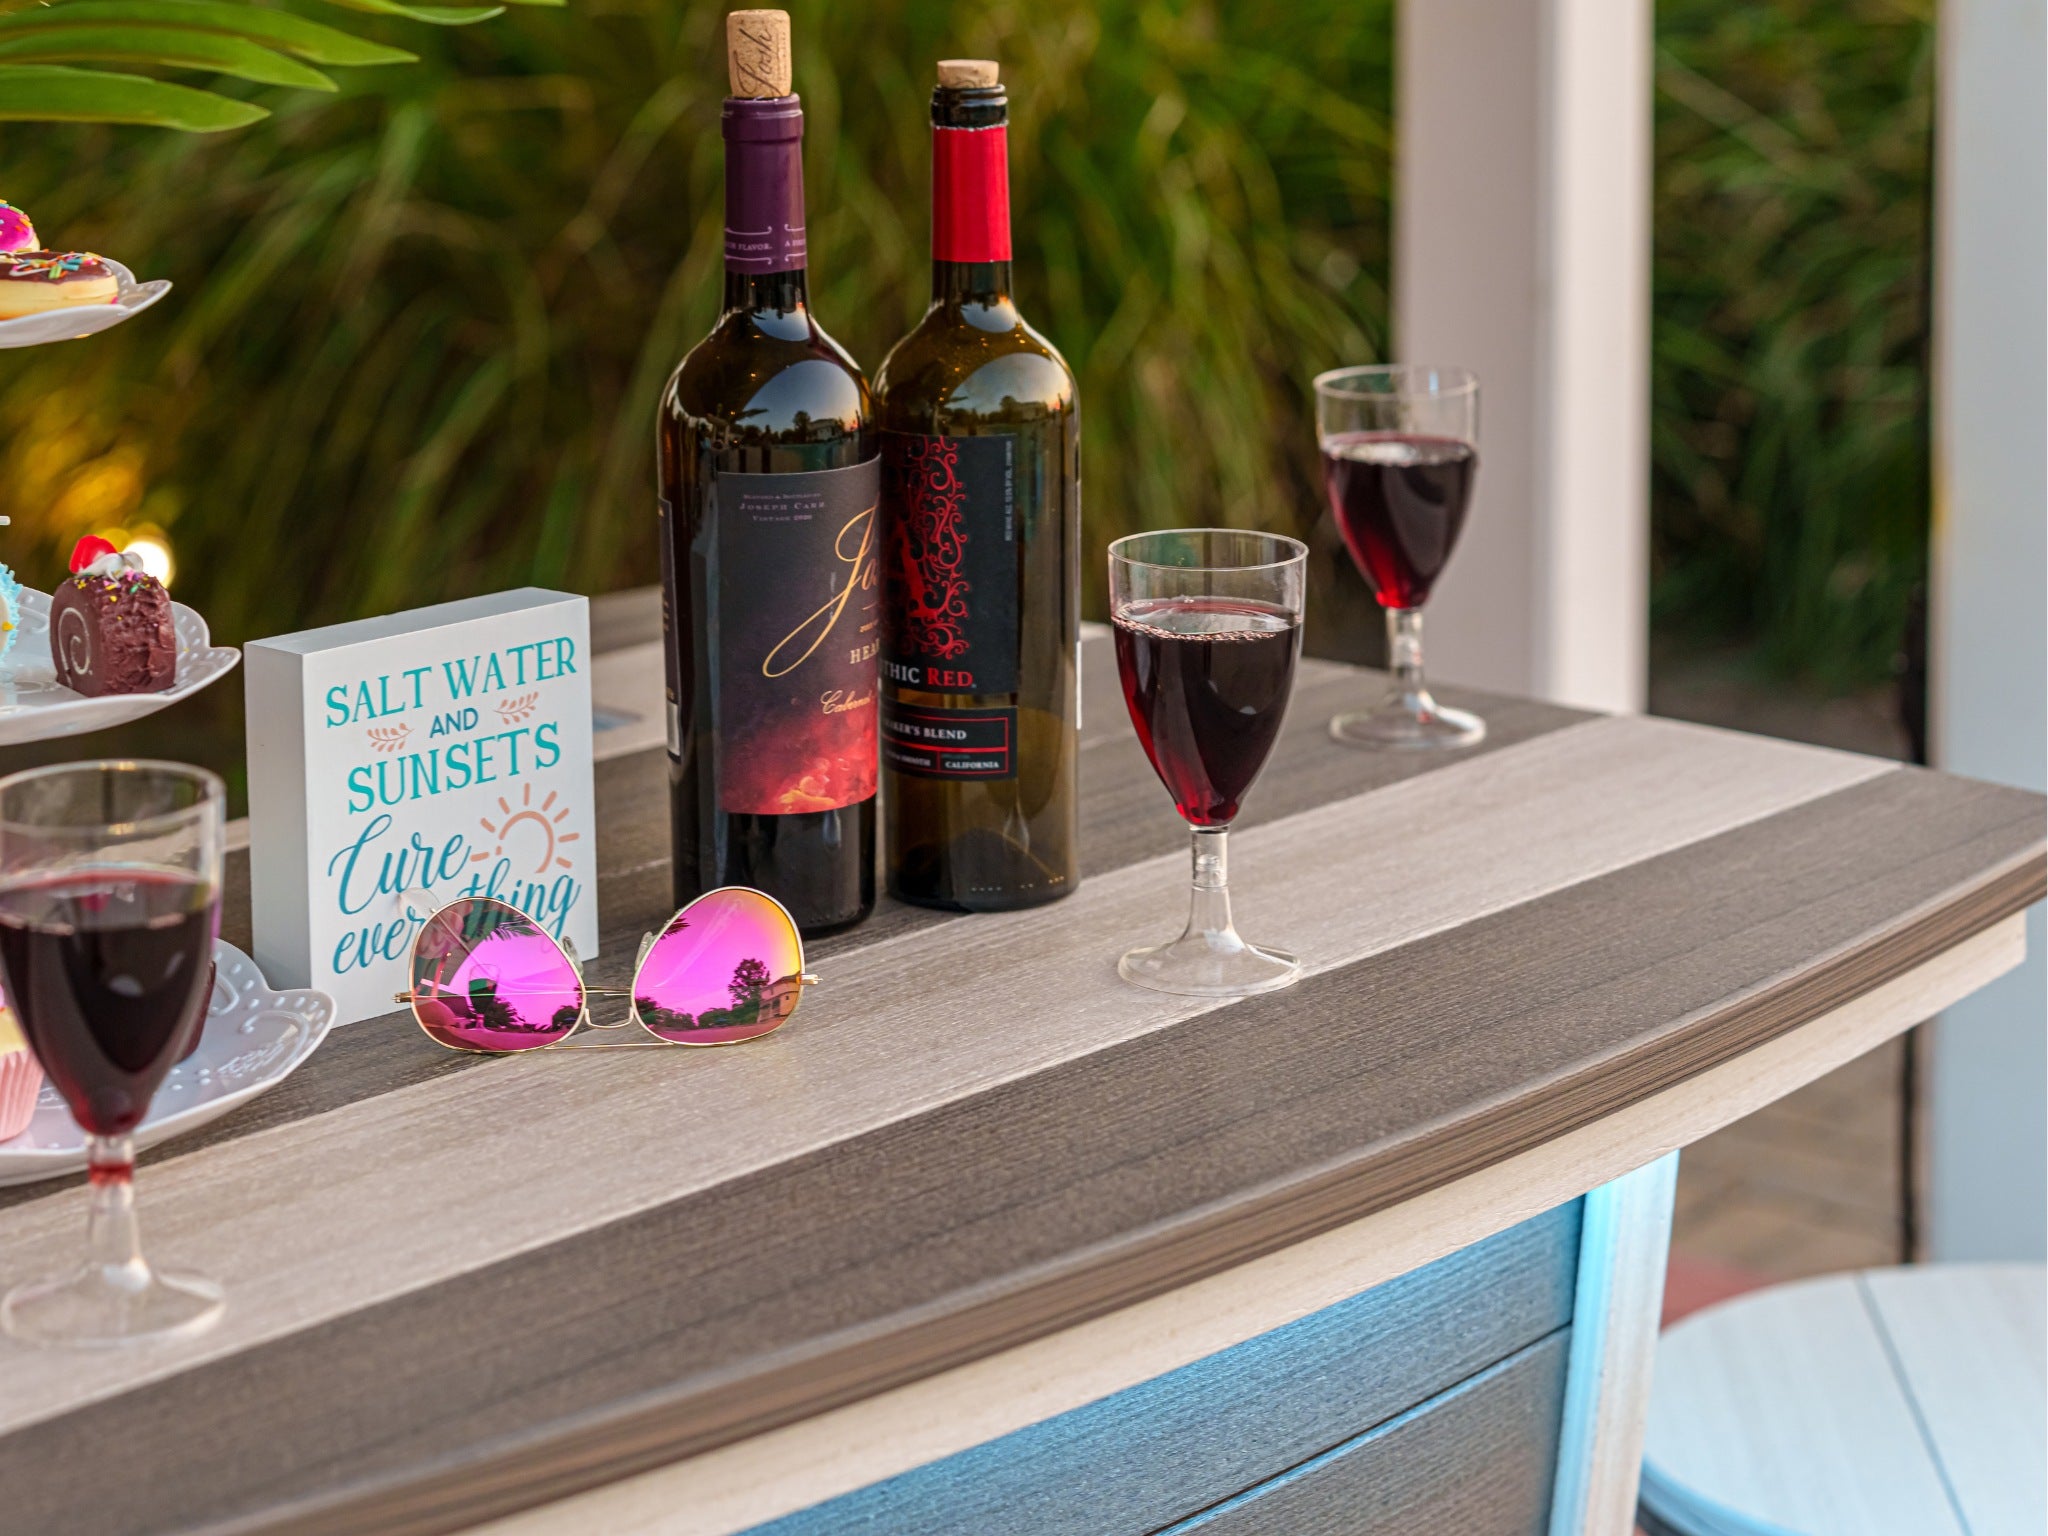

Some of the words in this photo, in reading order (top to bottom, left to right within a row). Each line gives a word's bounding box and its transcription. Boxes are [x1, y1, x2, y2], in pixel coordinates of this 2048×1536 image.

[733, 25, 783, 97] Josh
[326, 666, 432, 728] SALT
[442, 637, 577, 700] WATER
[429, 708, 479, 738] AND
[924, 727, 967, 740] BLEND
[348, 722, 560, 814] SUNSETS
[945, 761, 999, 769] CALIFORNIA
[328, 814, 472, 915] Cure
